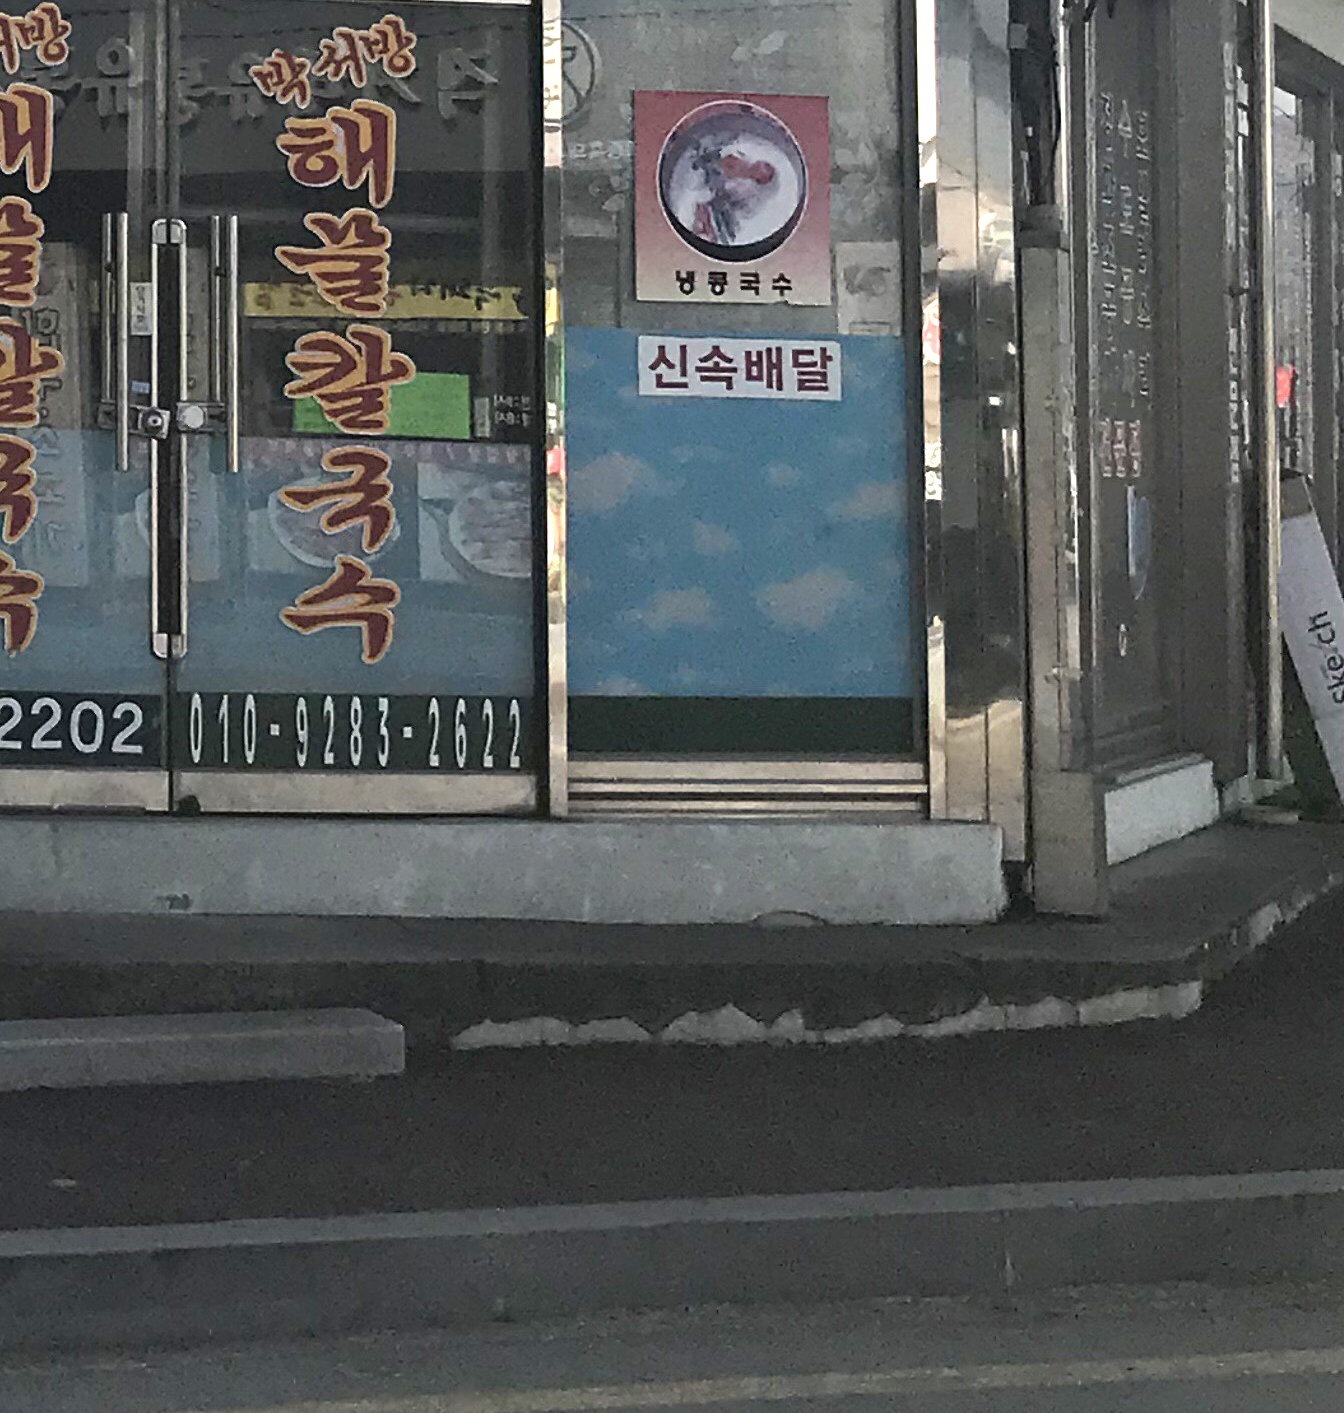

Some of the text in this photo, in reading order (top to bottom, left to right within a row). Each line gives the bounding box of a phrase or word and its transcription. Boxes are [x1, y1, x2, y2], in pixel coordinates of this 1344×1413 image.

[250, 14, 418, 109] 박서방
[676, 270, 793, 297] 냉콩국수
[276, 99, 417, 665] 해물칼국수
[648, 344, 834, 393] 신속배달
[188, 692, 524, 770] 010-9283-2622
